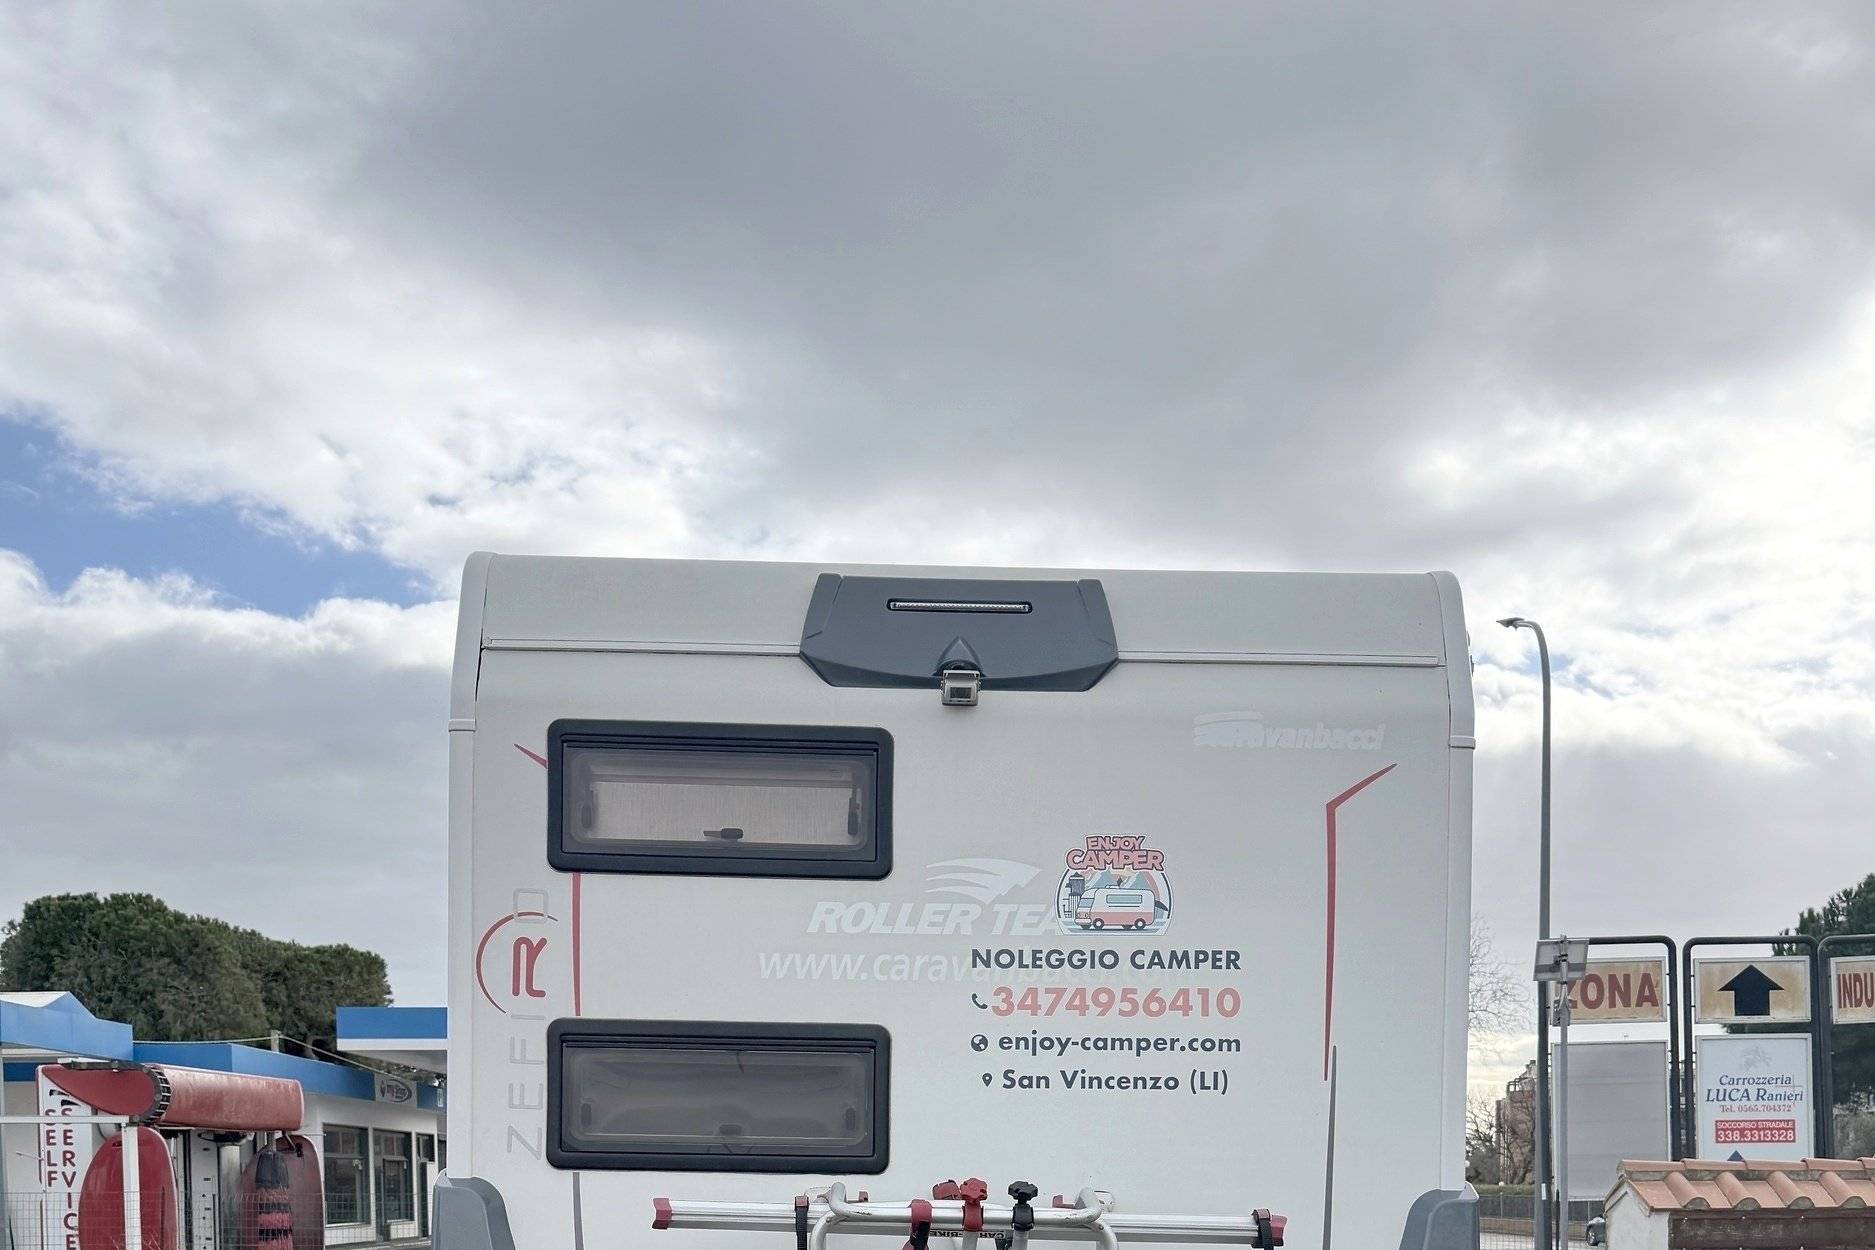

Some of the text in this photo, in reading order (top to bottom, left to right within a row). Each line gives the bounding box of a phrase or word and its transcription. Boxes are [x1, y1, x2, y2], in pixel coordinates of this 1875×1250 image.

[1085, 835, 1146, 850] ENJOY
[1066, 849, 1164, 871] CAMPER
[806, 901, 1061, 936] ROLLER TEA
[971, 948, 1242, 970] NOLEGGIO CAMPER
[991, 986, 1242, 1017] 3474956410
[999, 1029, 1242, 1057] enjoy-camper.com
[1002, 1068, 1229, 1095] San Vincenzo (LI)
[1719, 1074, 1792, 1086] Carrozzeria
[1706, 1088, 1804, 1102] LUCA Ranieri
[1717, 1121, 1757, 1129] SOCCORSO
[1717, 1130, 1794, 1142] 338.3313328
[44, 1108, 58, 1188] SELF
[61, 1107, 78, 1250] SERVICE
